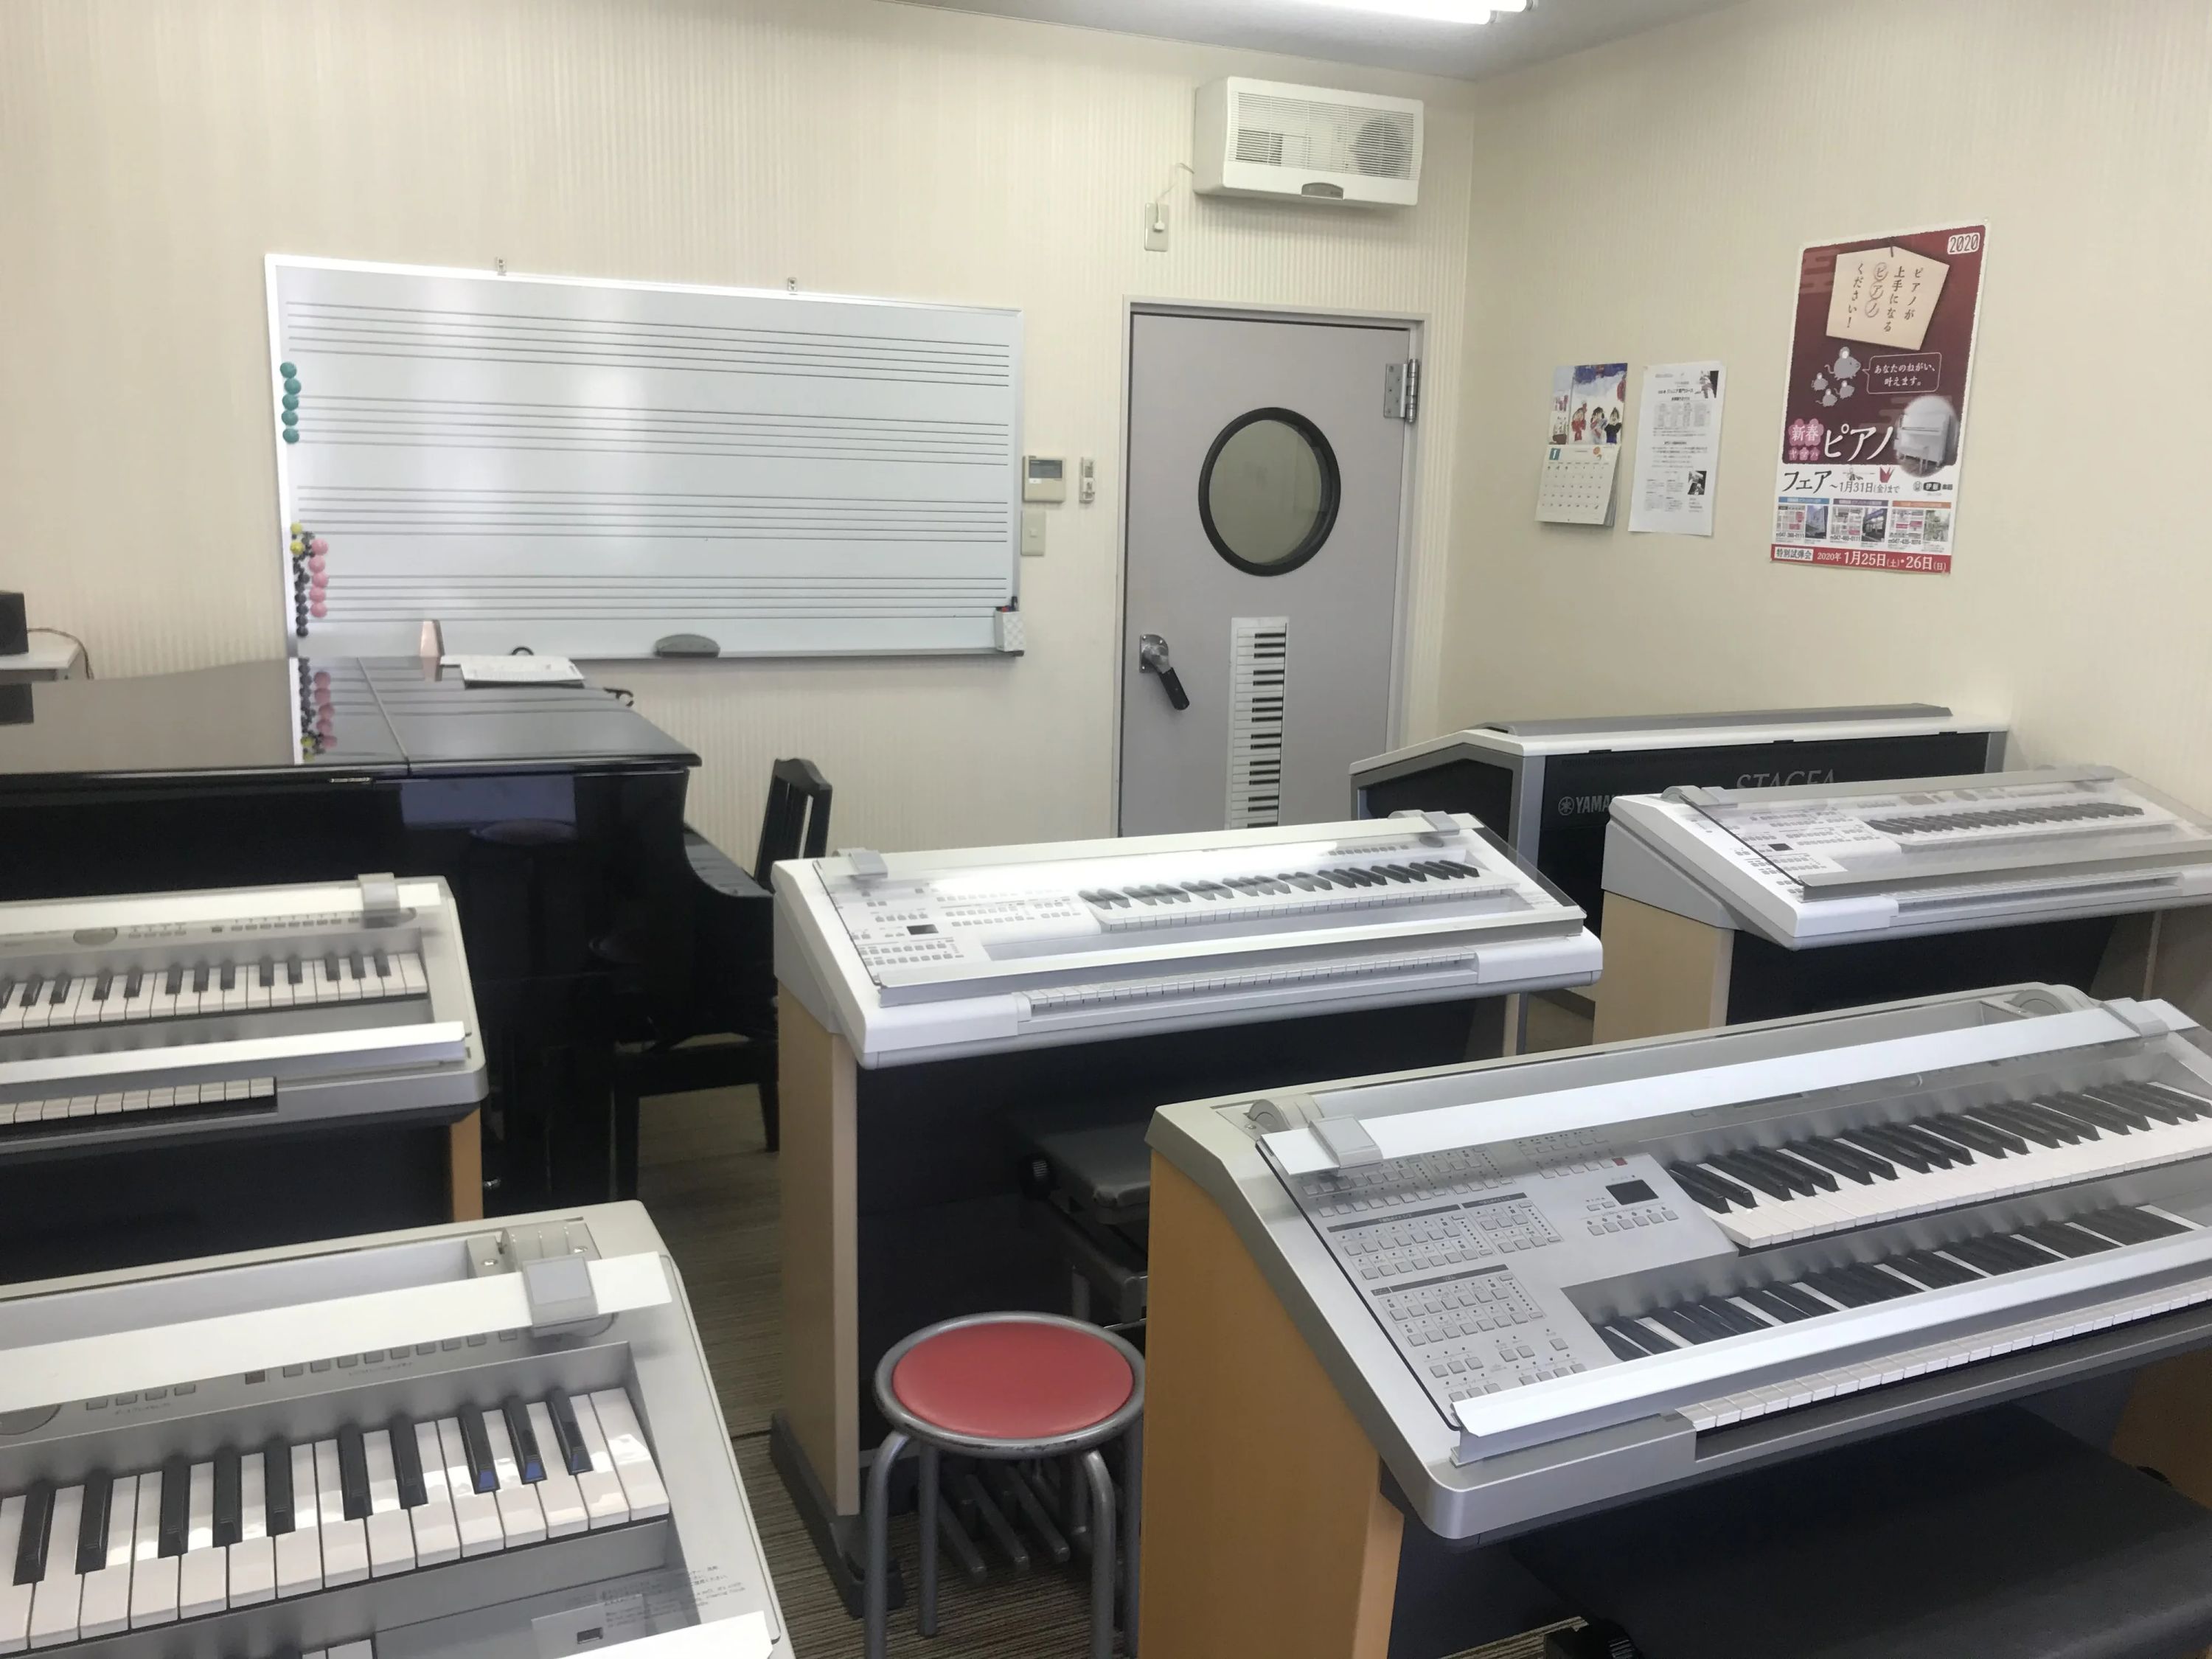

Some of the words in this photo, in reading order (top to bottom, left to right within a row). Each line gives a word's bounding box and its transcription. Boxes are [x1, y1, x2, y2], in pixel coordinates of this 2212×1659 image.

[1949, 234, 1979, 253] 2020
[1865, 263, 1888, 317] ピアノ
[1884, 265, 1905, 332] 上手になる
[1904, 267, 1924, 320] ピアノが
[1791, 424, 1819, 442] 新春
[1824, 423, 1894, 462] ピアノ
[1781, 470, 1832, 495] フェア
[1817, 552, 1842, 561] 2020年
[1576, 795, 1614, 814] YAMA
